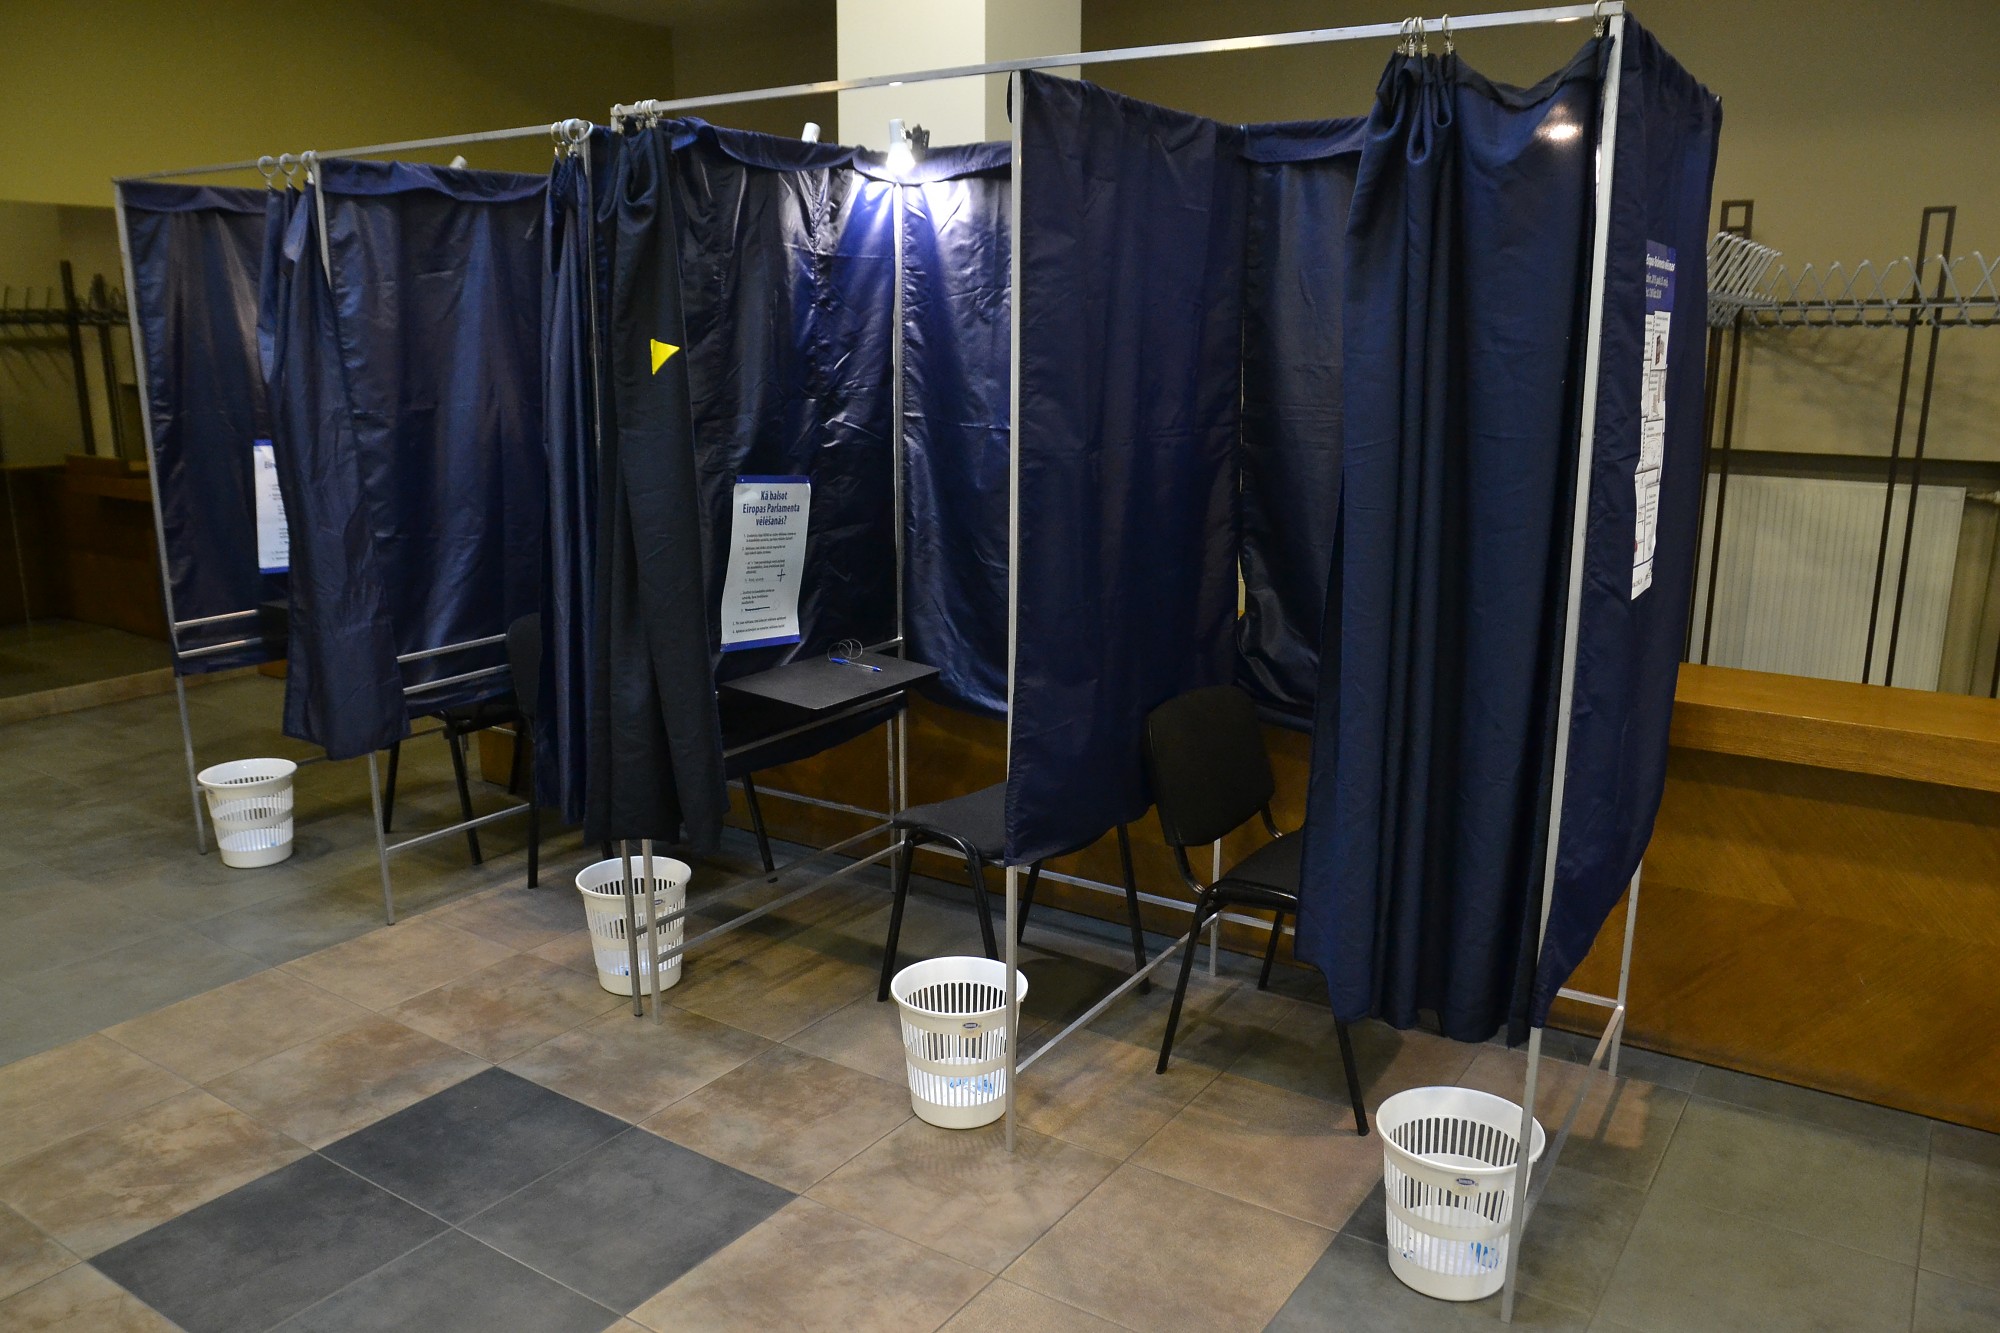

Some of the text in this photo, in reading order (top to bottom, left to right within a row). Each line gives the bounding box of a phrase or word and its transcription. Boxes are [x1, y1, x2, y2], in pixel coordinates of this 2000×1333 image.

[761, 490, 787, 500] Kā balsot
[743, 503, 800, 515] Eiropas Parlamenta
